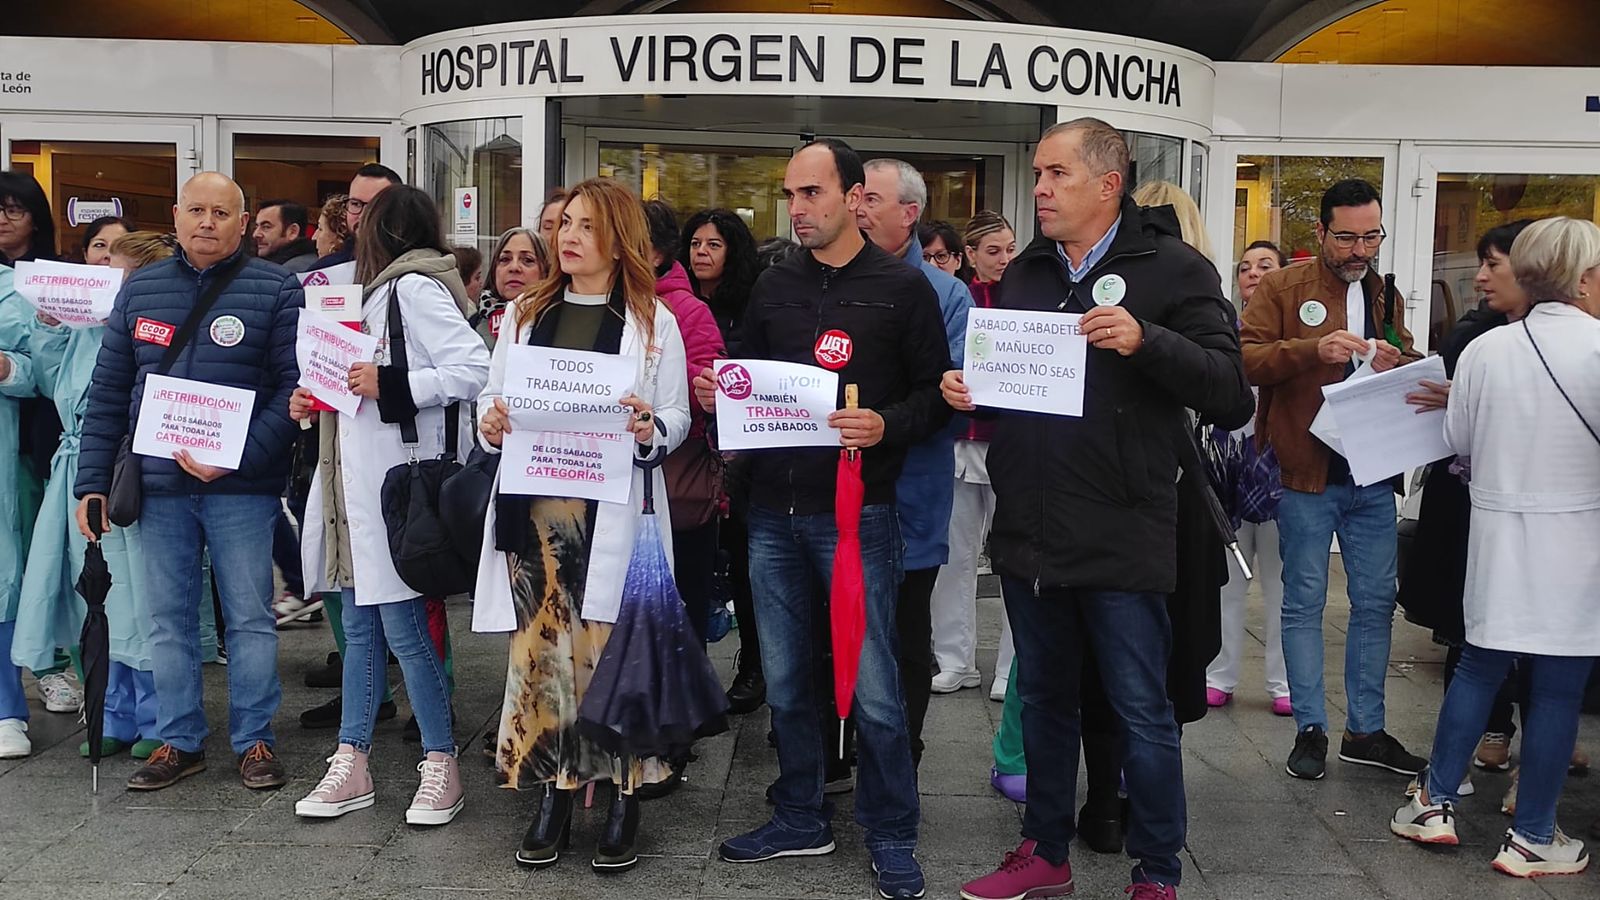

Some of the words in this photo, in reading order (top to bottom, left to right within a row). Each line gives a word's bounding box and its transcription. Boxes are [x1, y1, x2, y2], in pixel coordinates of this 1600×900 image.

[16, 71, 31, 81] de
[421, 37, 584, 96] HOSPITAL
[609, 33, 824, 83] VIRGEN
[850, 36, 925, 86] DE
[951, 40, 1012, 90] LA
[1027, 45, 1181, 107] CONCHA
[2, 83, 31, 93] León
[142, 324, 166, 336] CCOO
[820, 334, 850, 354] UGT
[995, 340, 1054, 355] MAÑUECO
[550, 358, 594, 374] TODOS
[972, 361, 1026, 374] PAGANOS
[1029, 363, 1048, 376] NO
[1050, 366, 1076, 379] SEAS
[718, 366, 746, 385] UGT
[779, 376, 821, 390] ¡¡YO!!
[526, 377, 612, 396] TRABAJAMOS
[998, 381, 1048, 397] ZOQUETE
[505, 396, 550, 412] TODOS
[553, 401, 630, 414] COBRAMOS
[752, 393, 797, 404] TAMBIÉN
[746, 406, 810, 418] TRABAJO
[163, 413, 172, 421] DE
[173, 415, 187, 423] LOS
[188, 417, 222, 429] SÁBADOS
[743, 424, 765, 432] LOS
[767, 421, 818, 432] SÁBADOS
[161, 423, 179, 431] PARA
[182, 426, 205, 436] TODAS
[207, 430, 221, 438] LAS
[156, 432, 222, 449] CATEGORÍAS
[545, 446, 562, 454] LOS
[563, 446, 603, 459] SÁBADOS
[557, 458, 585, 467] TODAS
[527, 467, 605, 481] CATEGORÍAS
